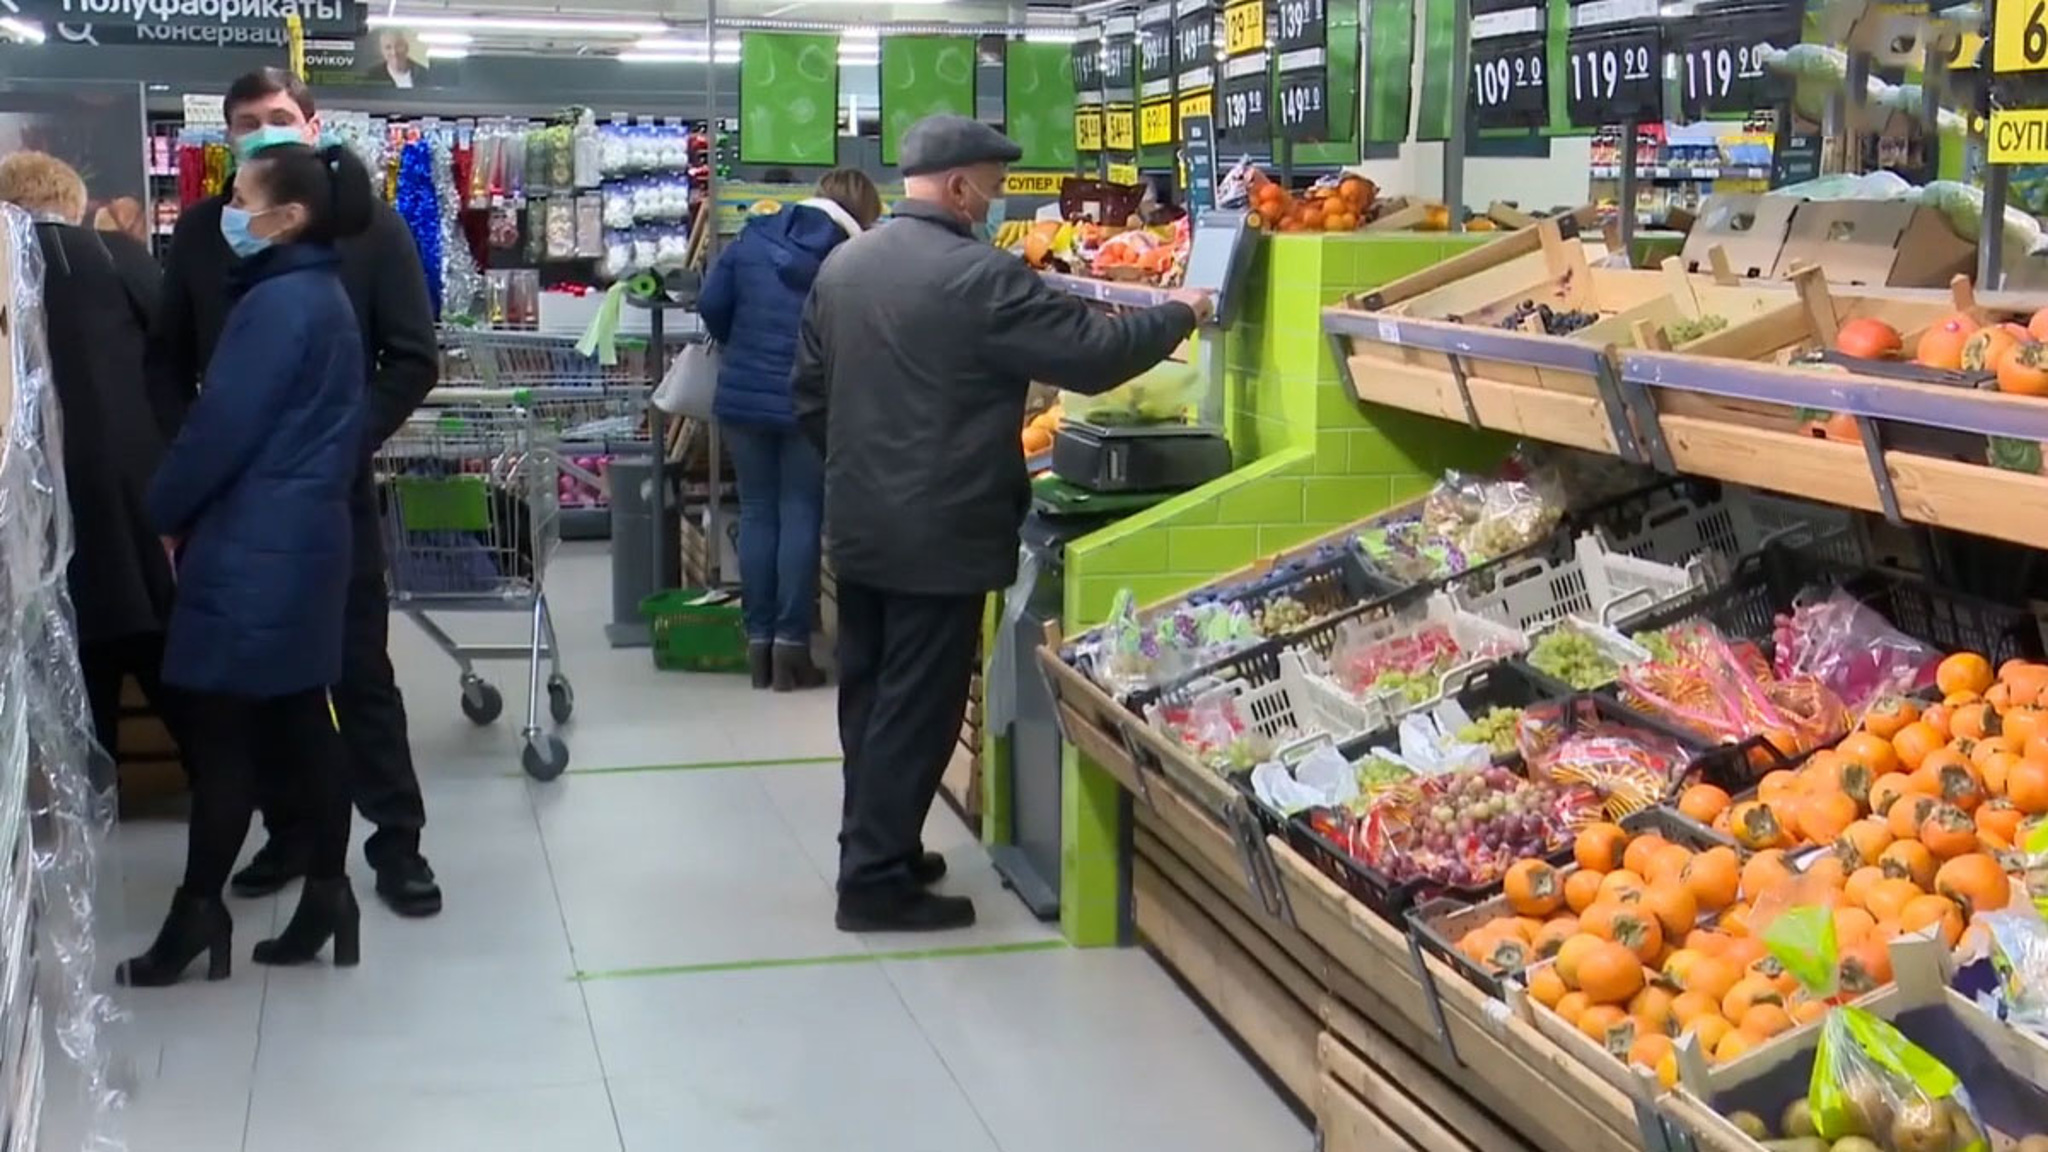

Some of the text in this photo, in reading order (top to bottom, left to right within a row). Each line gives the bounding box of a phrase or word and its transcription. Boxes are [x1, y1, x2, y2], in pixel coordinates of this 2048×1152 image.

[1280, 2, 1303, 39] 139
[303, 51, 354, 66] ovikov
[1571, 47, 1649, 101] 119 90
[1686, 48, 1732, 99] 119
[1474, 56, 1542, 105] 109 90
[1226, 93, 1247, 128] 139
[1280, 87, 1304, 126] 149
[1008, 176, 1054, 190] СУПЕР
